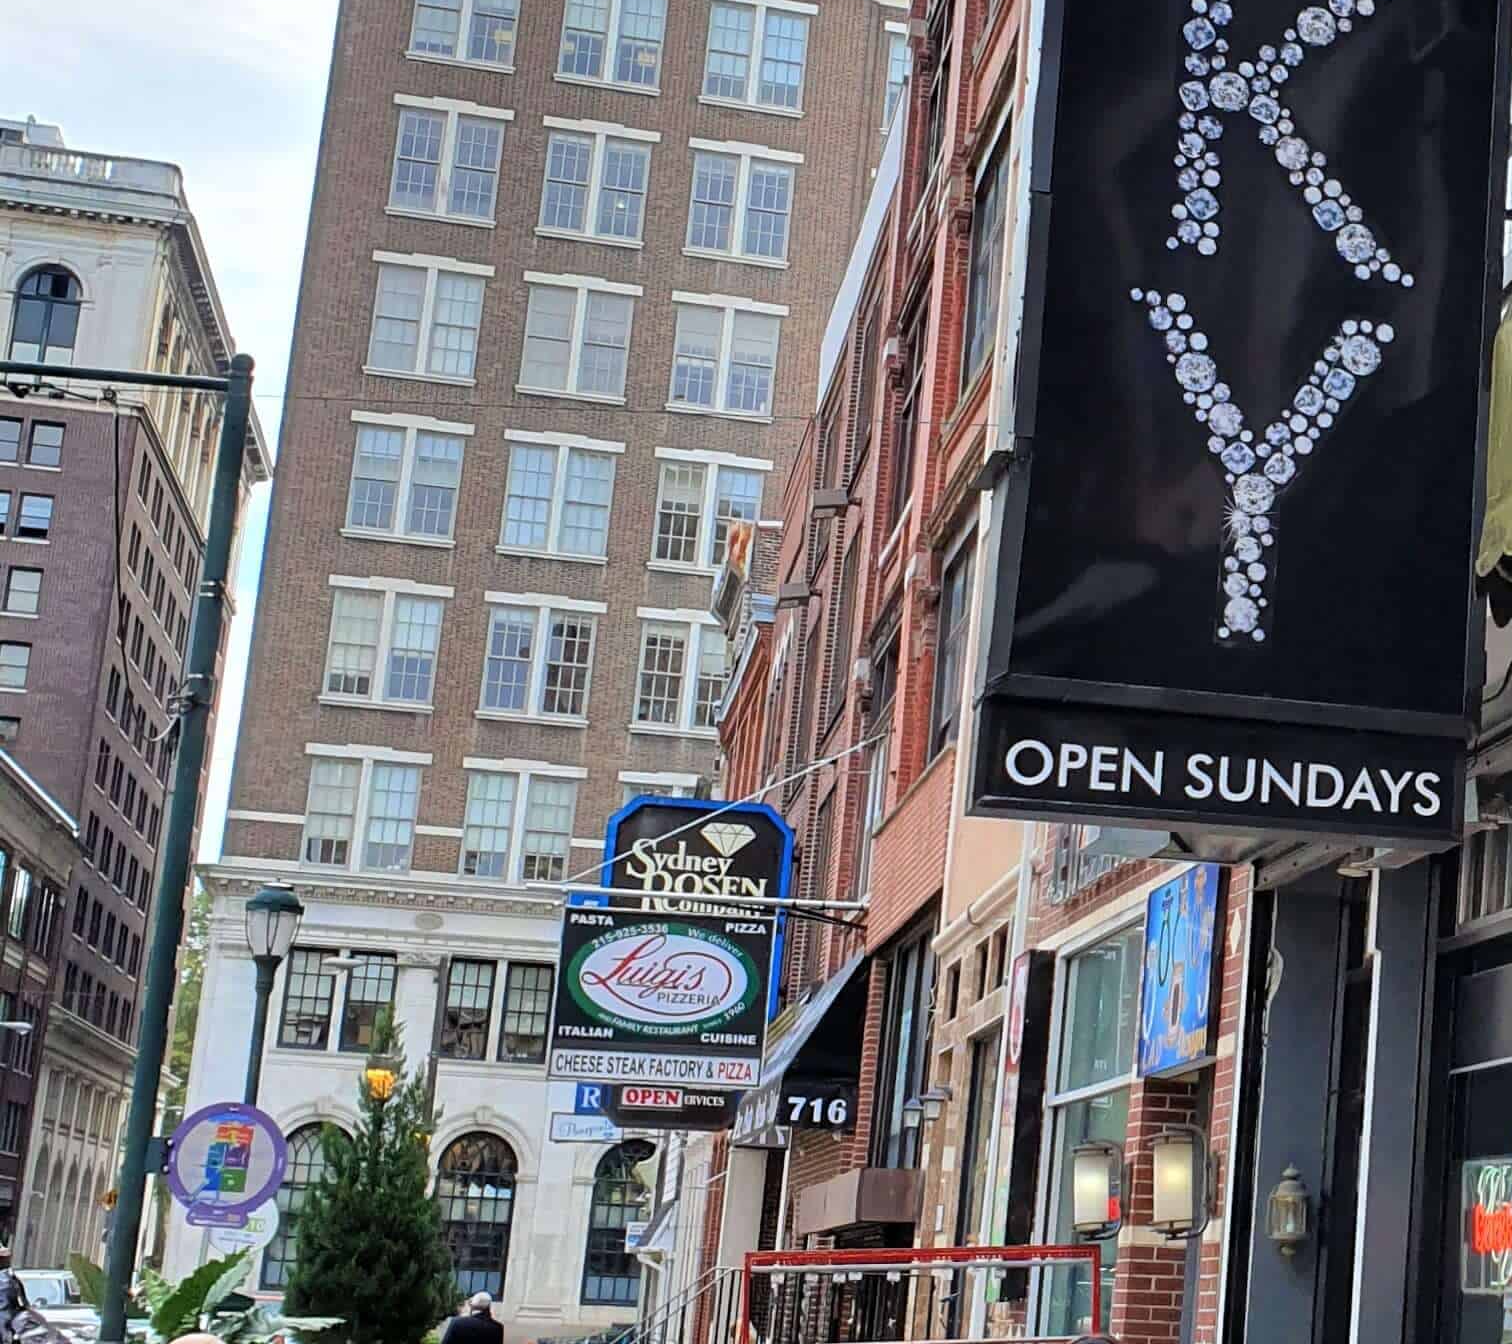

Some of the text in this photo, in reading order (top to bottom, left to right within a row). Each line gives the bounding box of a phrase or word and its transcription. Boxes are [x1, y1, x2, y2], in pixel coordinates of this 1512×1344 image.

[1005, 738, 1442, 818] OPEN SUNDAYS
[626, 837, 734, 881] Sydney
[569, 913, 614, 927] PASTA
[725, 921, 767, 936] PIZZA
[656, 991, 721, 1007] PIZZERIA
[557, 1025, 614, 1039] ITALIAN
[700, 1031, 757, 1045] CUISINE
[555, 1054, 753, 1081] CHEESE STEAK FACTORY & PIZZA
[624, 1087, 680, 1105] OPEN
[786, 1096, 848, 1125] 716
